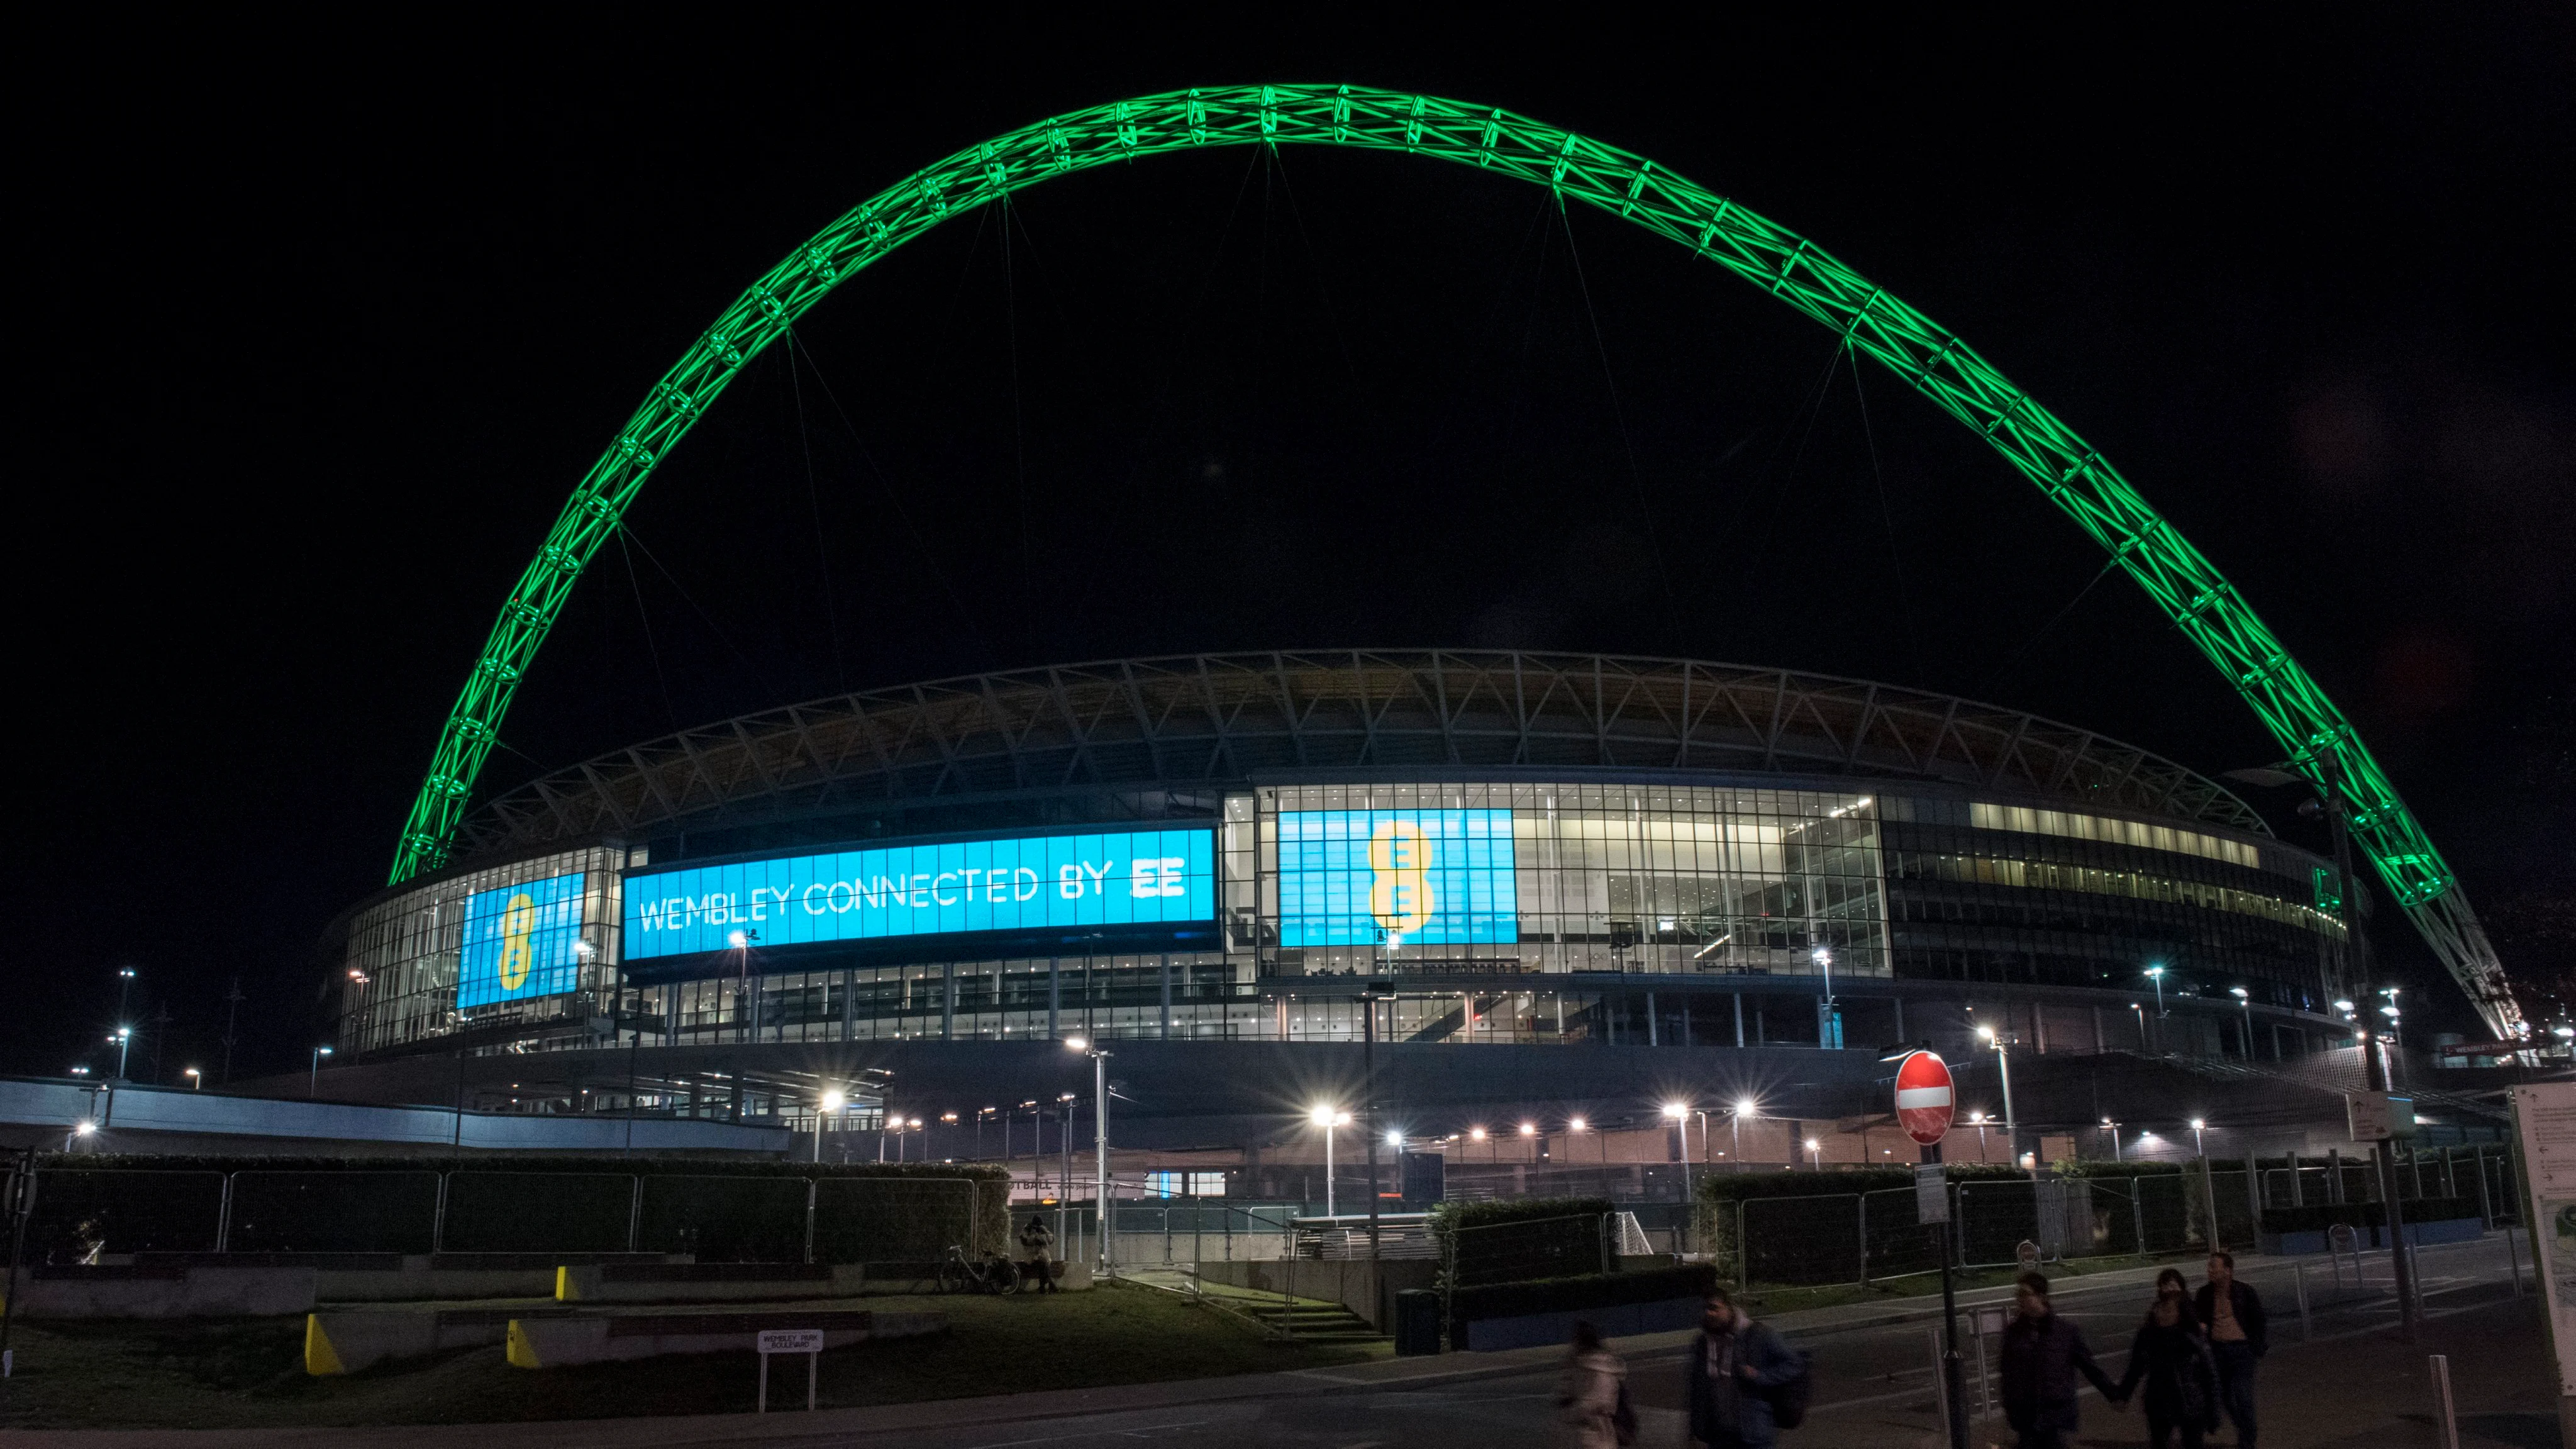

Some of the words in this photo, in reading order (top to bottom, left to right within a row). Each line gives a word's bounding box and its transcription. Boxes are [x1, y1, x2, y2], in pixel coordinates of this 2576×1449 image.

[640, 883, 796, 933] WEMBLEY
[802, 867, 1038, 916] CONNECTED
[1058, 860, 1113, 900] BY
[1129, 857, 1186, 899] EE
[2455, 1044, 2490, 1053] WEMBLEY
